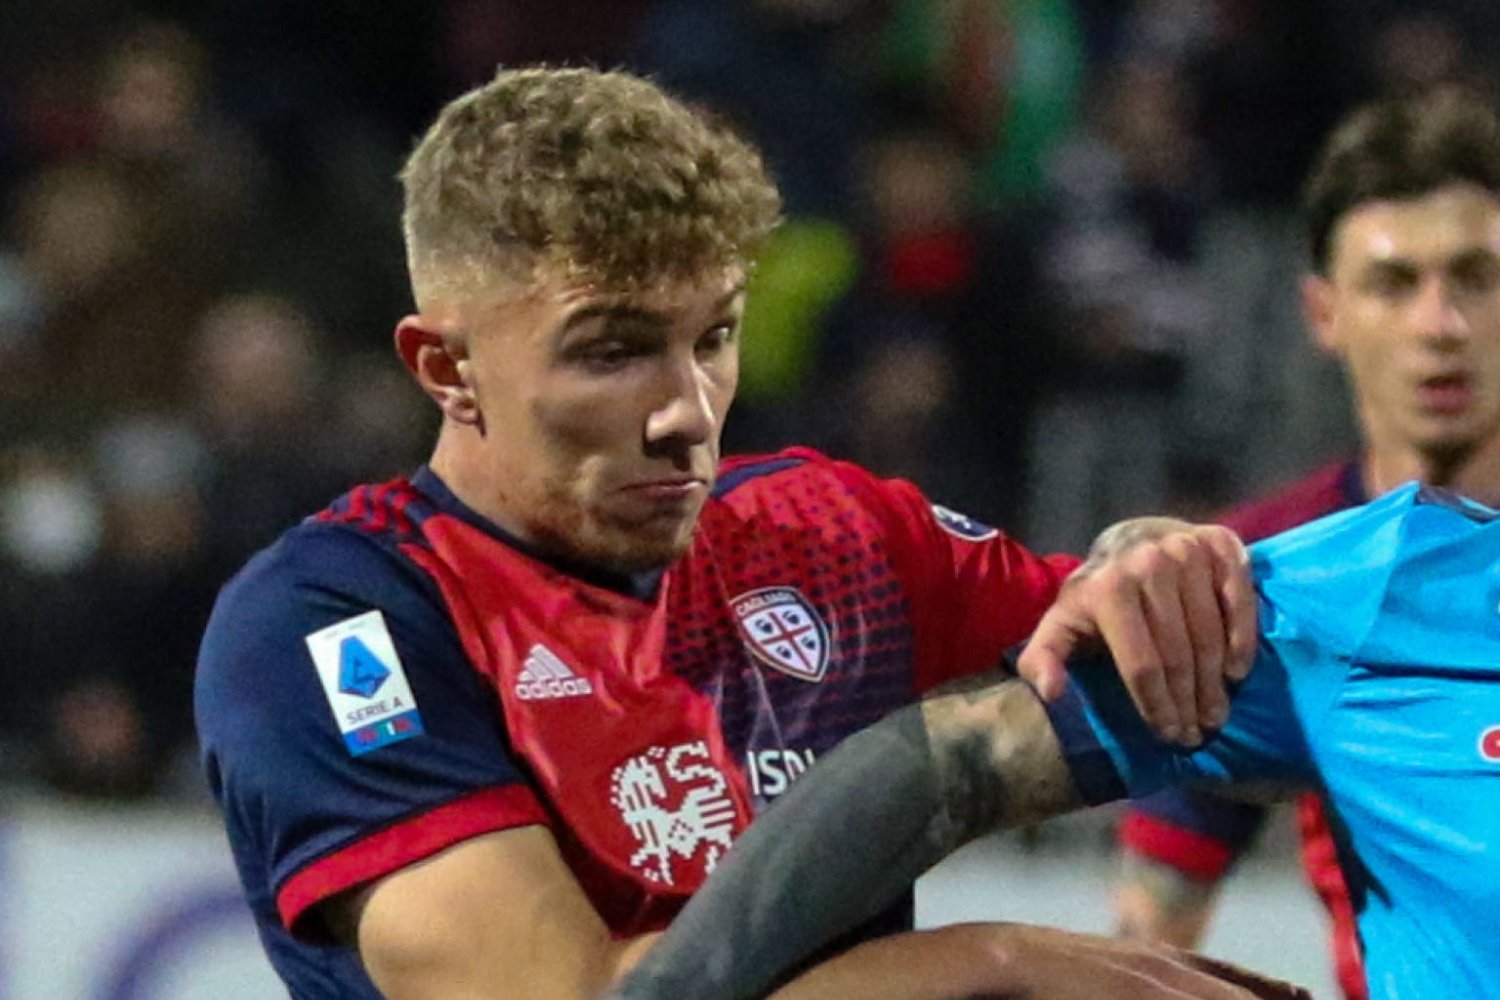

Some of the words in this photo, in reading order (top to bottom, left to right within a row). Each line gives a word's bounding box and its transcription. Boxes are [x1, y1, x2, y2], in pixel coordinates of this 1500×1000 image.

[514, 677, 593, 700] adidas
[346, 701, 388, 725] SERIE
[393, 696, 404, 709] A
